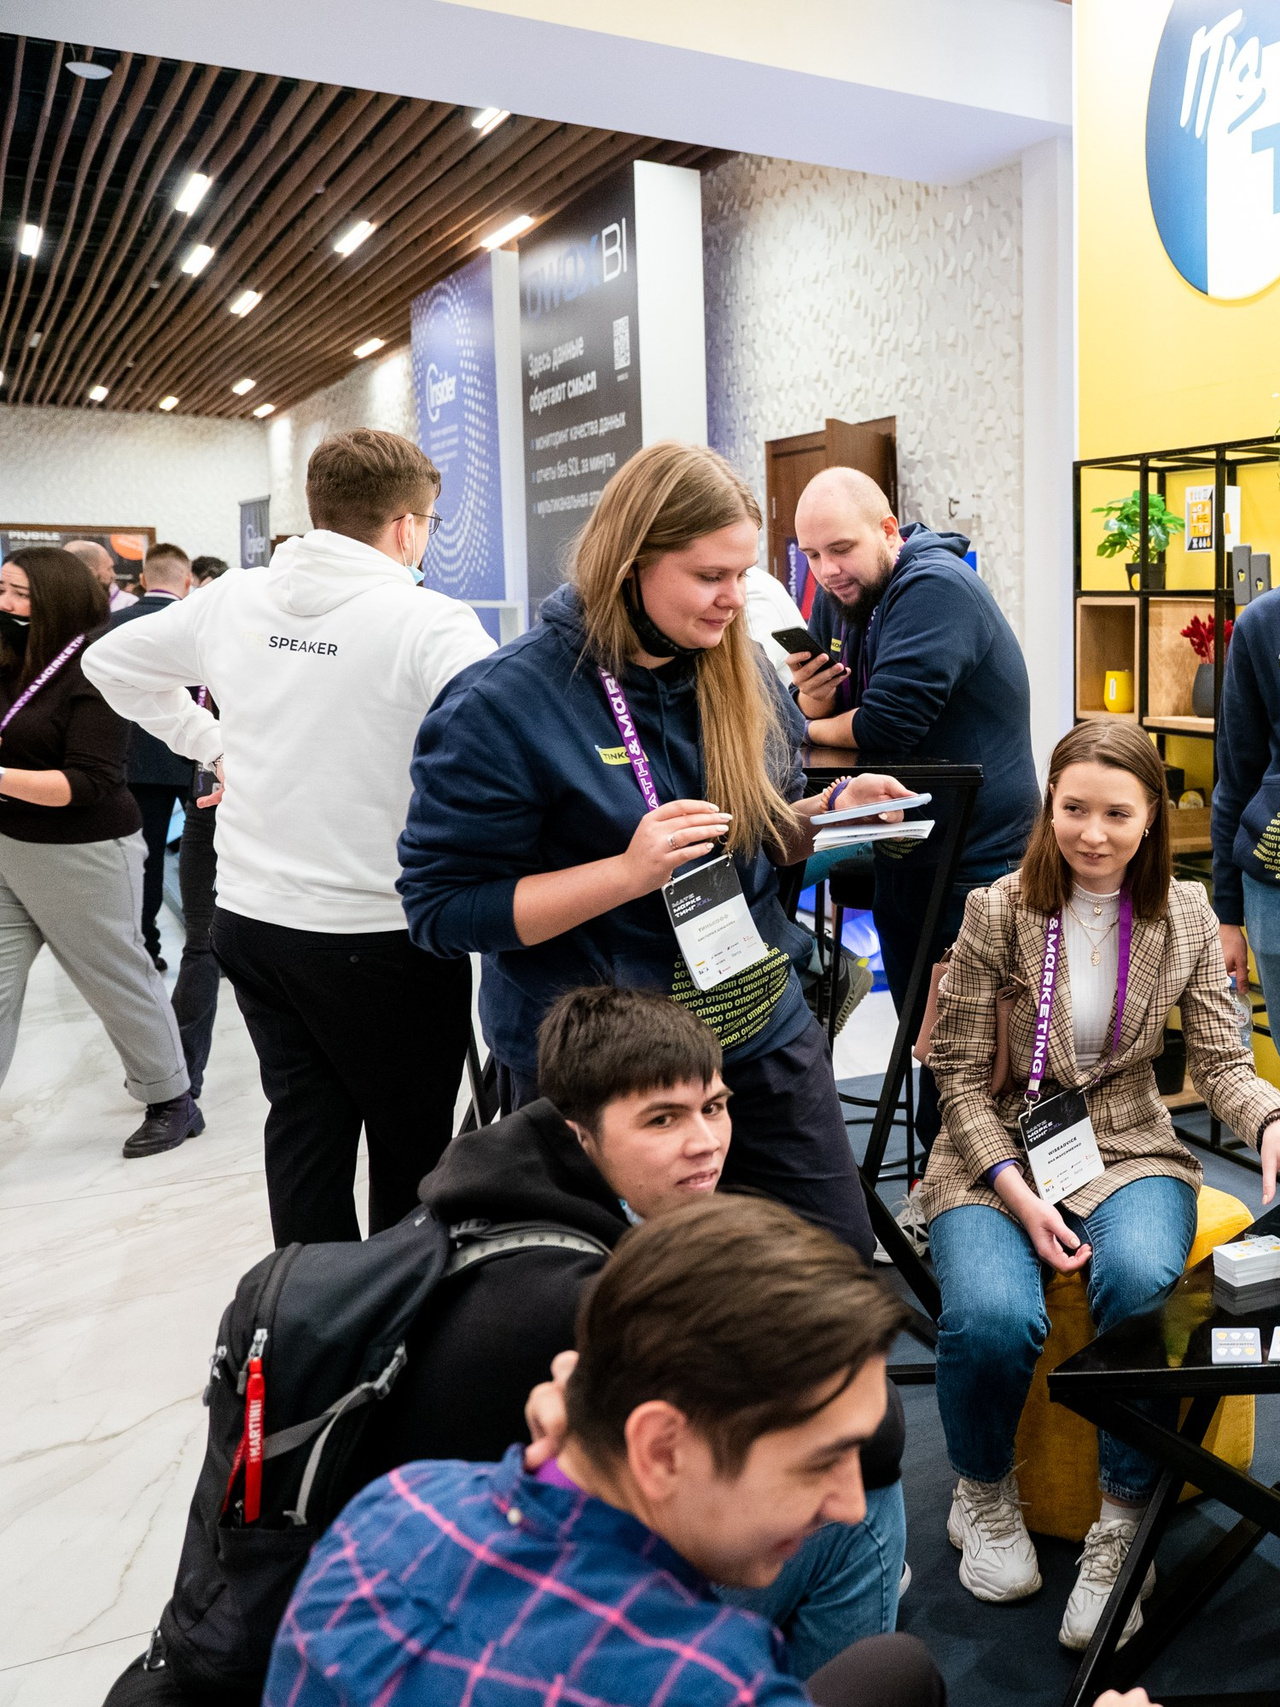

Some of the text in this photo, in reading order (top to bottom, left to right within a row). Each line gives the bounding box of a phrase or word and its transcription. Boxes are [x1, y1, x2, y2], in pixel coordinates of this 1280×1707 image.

[602, 217, 627, 283] BI
[552, 336, 584, 372] данные
[529, 371, 597, 415] обретают смысл
[599, 411, 626, 436] данных
[788, 543, 797, 604] alweb
[268, 636, 338, 656] SPEAKER
